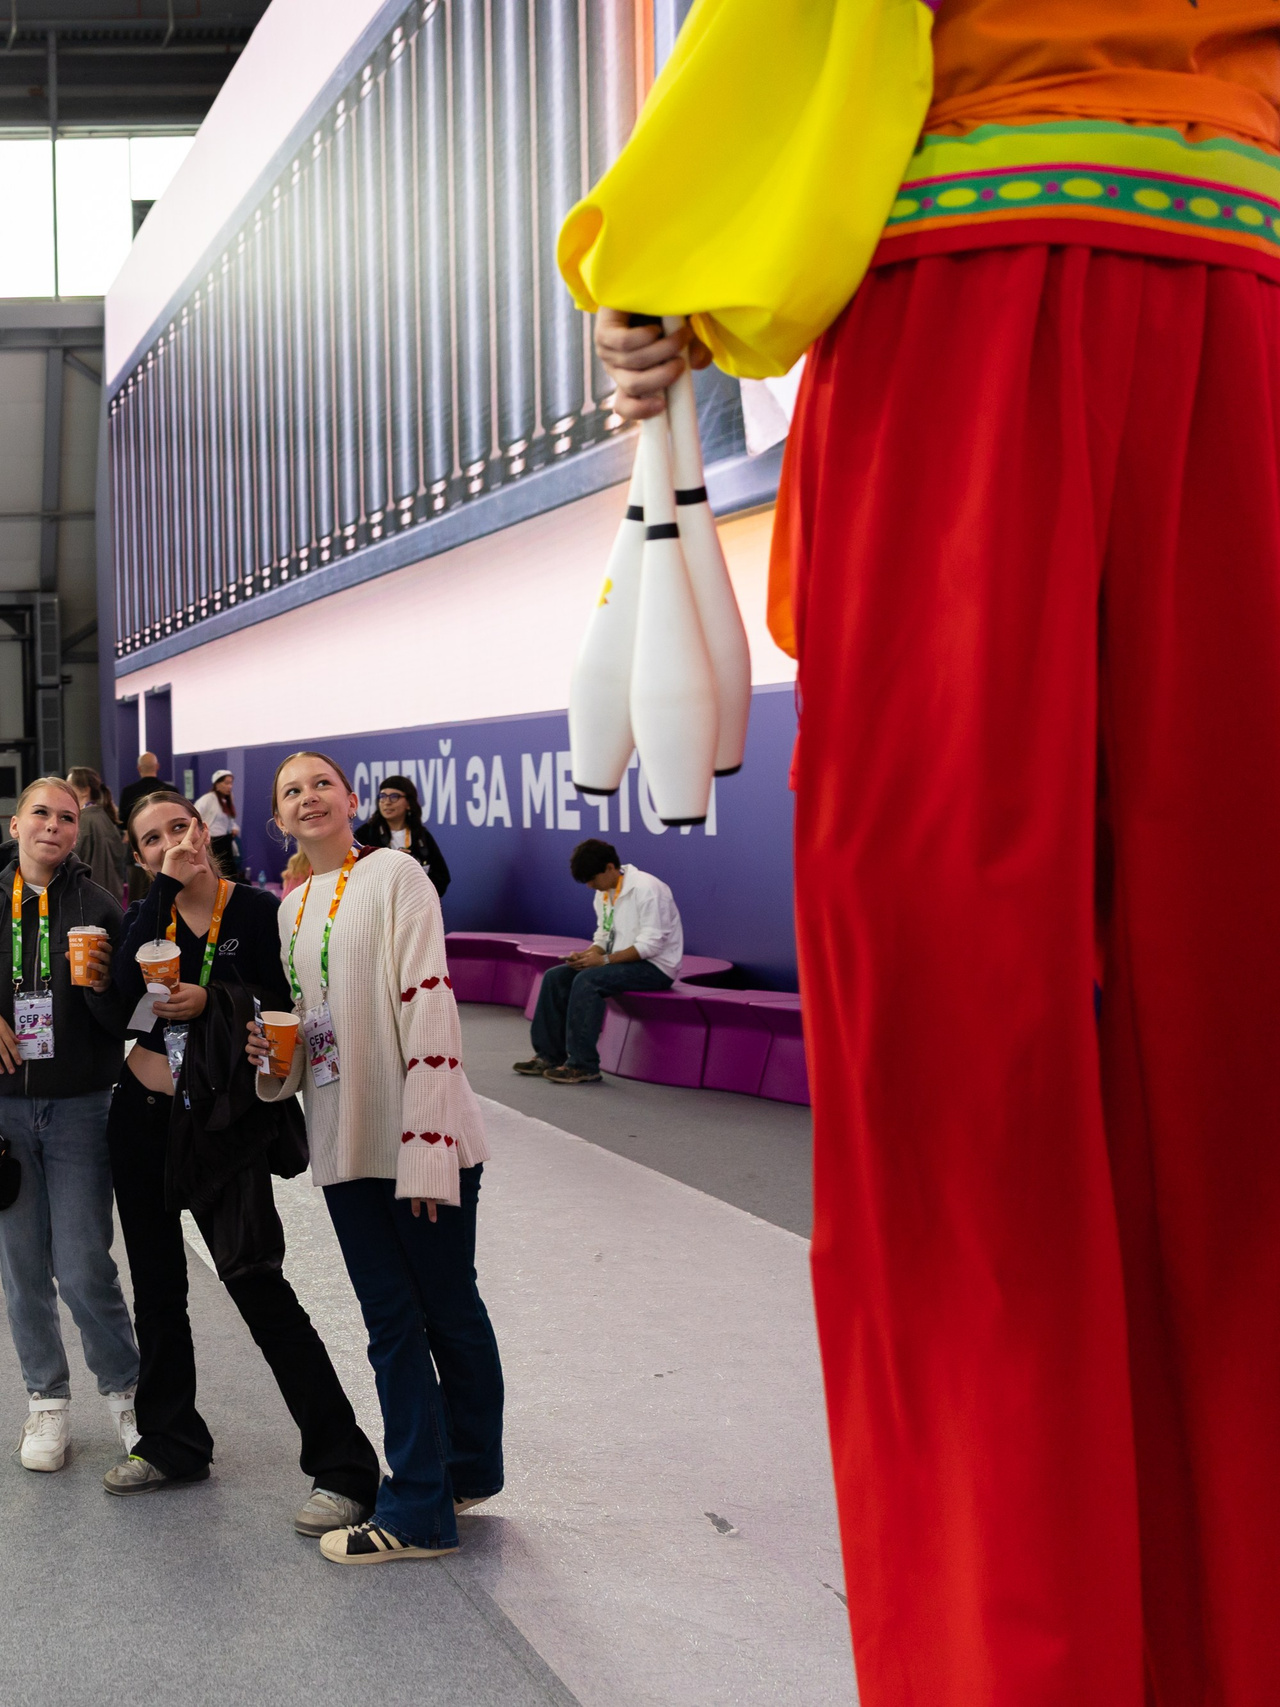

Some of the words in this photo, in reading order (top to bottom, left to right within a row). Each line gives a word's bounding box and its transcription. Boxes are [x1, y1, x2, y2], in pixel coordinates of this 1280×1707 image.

[354, 738, 457, 826] СЛУЙ
[466, 754, 512, 828] ЗА
[521, 750, 718, 836] МЕТО
